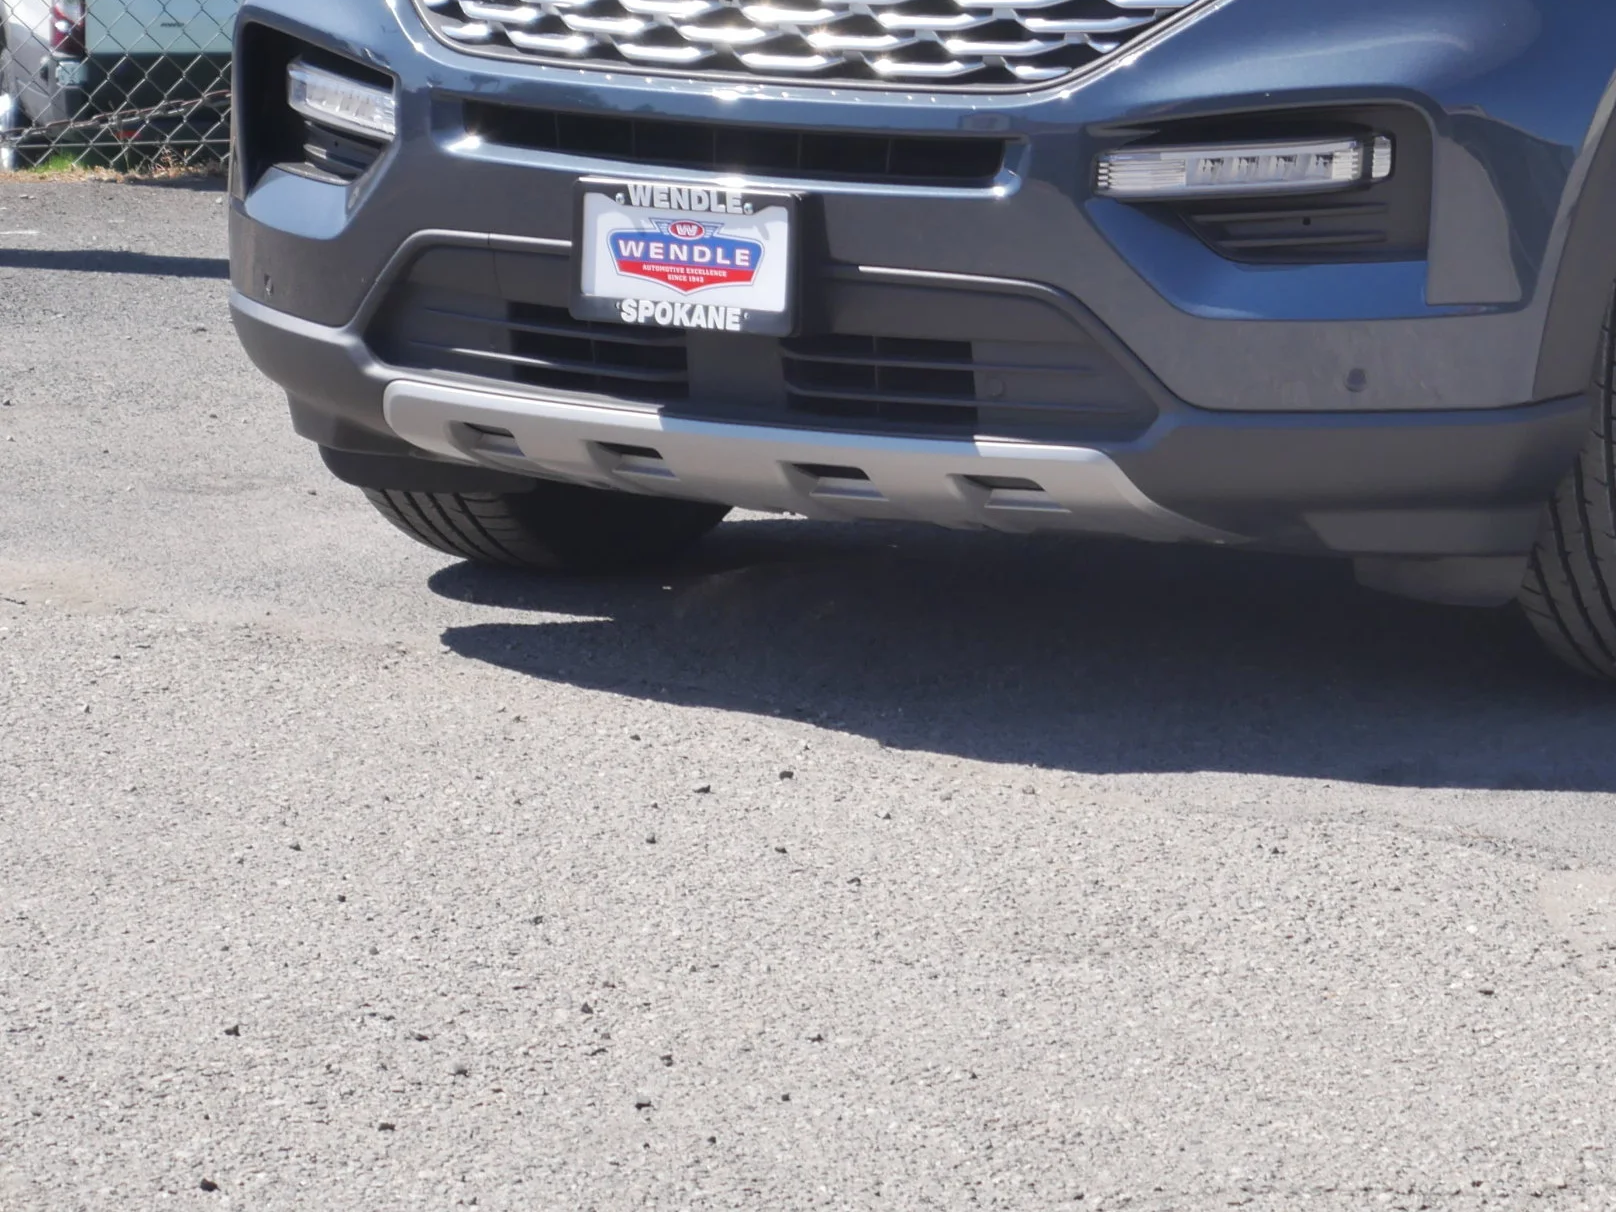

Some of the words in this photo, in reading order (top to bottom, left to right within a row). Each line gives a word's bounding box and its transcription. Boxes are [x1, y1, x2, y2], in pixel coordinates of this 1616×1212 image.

[627, 184, 745, 215] WENDLE
[618, 239, 751, 267] WENDLE
[642, 264, 685, 275] AUTOMOTIVE
[686, 267, 728, 278] EXCELLENCE
[667, 273, 688, 283] SINCE
[620, 299, 741, 331] SPOKANE
